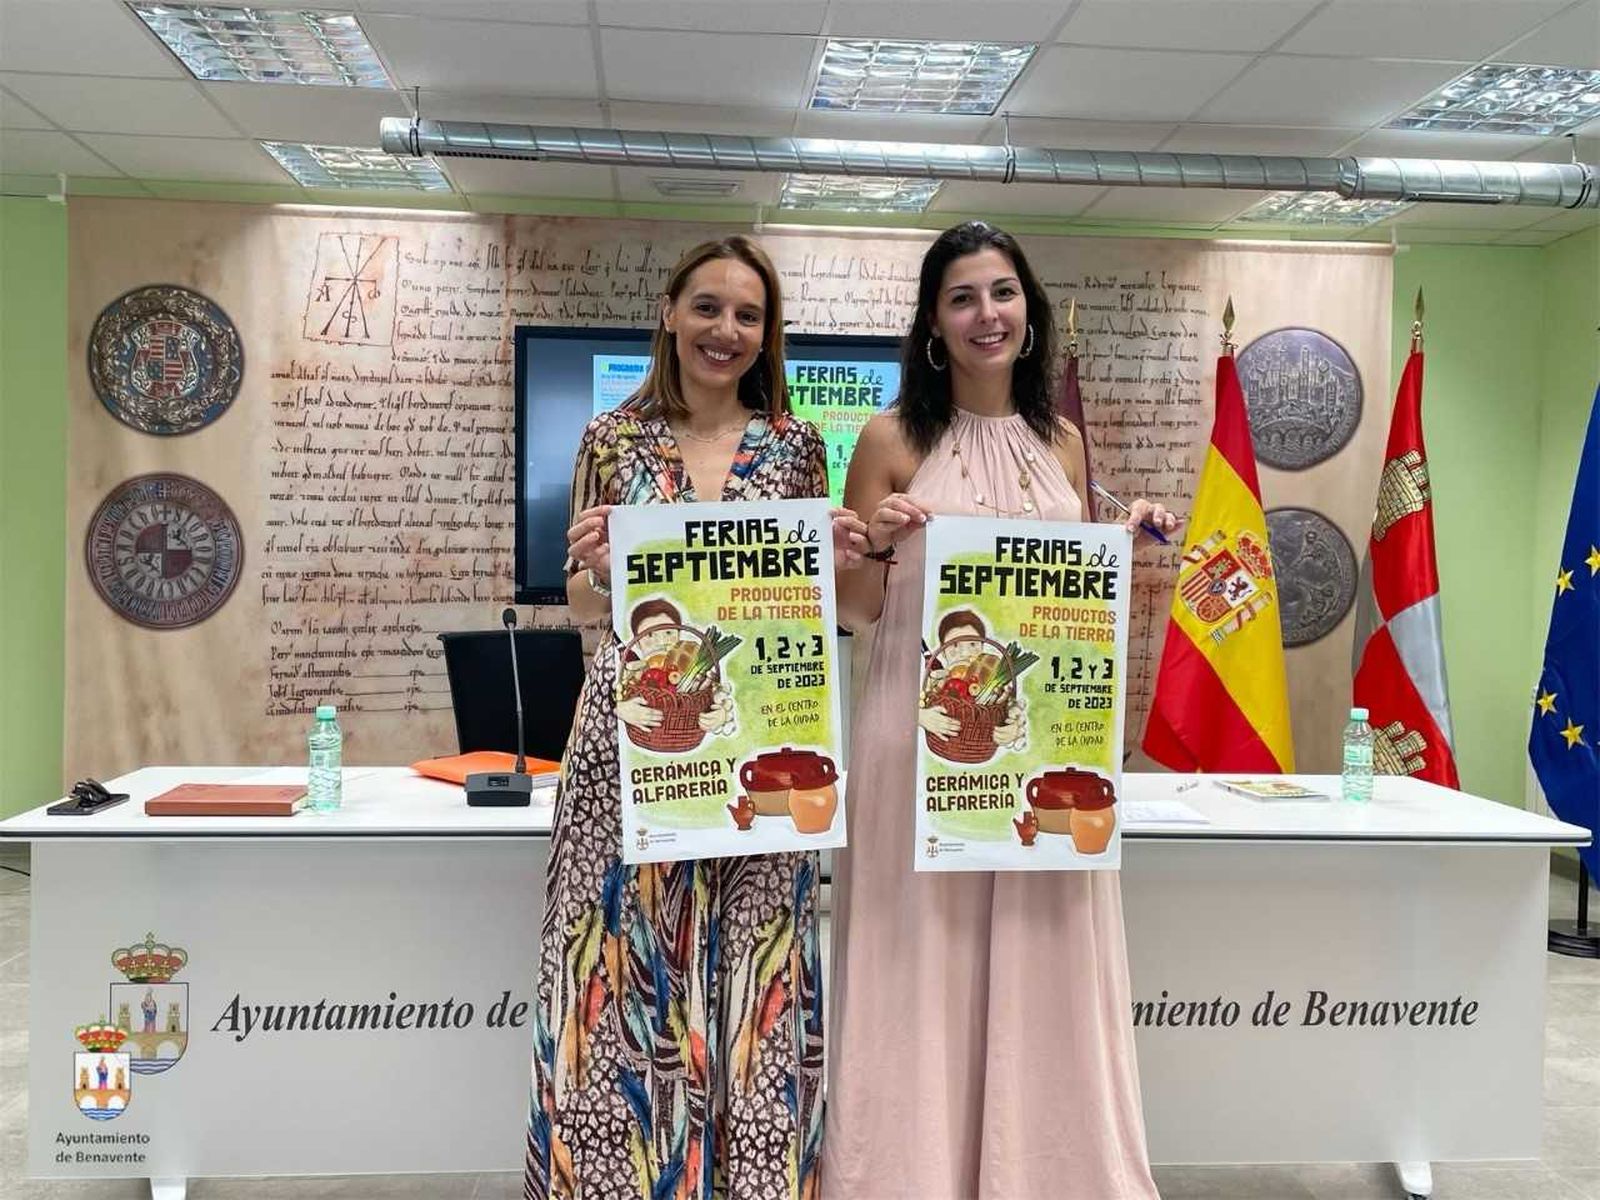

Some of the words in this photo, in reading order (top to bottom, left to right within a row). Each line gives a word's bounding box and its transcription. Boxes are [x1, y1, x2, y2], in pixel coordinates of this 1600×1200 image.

[796, 366, 857, 384] FERIAS
[860, 368, 884, 386] de
[788, 385, 883, 406] TIEMBRE
[823, 411, 871, 422] PRODUCT
[685, 518, 780, 548] FERIAS
[784, 520, 821, 544] de
[995, 536, 1082, 566] FERIAS
[1085, 543, 1120, 568] de
[627, 546, 820, 585] SEPTIEMBRE
[939, 564, 1118, 600] SEPTIEMBRE
[730, 586, 822, 602] PRODUCTOS
[718, 606, 736, 621] DE
[743, 606, 762, 620] LA
[769, 604, 822, 620] TIERRA
[1033, 605, 1117, 625] PRODUCTOS
[1019, 623, 1037, 638] DE
[1042, 624, 1061, 640] LA
[1066, 625, 1115, 642] TIERRA
[755, 637, 772, 662] 1,
[777, 636, 791, 659] 2
[811, 635, 824, 656] 3
[751, 664, 763, 674] DE
[767, 661, 824, 674] SEPTIEMBRE
[1051, 656, 1065, 682] 1,
[1071, 657, 1082, 679] 2
[1102, 657, 1113, 679] 3
[777, 678, 791, 689] DE
[795, 674, 825, 688] 2023
[1045, 683, 1057, 693] DE
[1060, 683, 1113, 694] SEPTIEMBRE
[761, 704, 773, 715] EN
[776, 703, 786, 713] EL
[788, 699, 819, 712] CENTRO
[1068, 698, 1081, 709] DE
[1084, 696, 1112, 709] 2023
[768, 717, 779, 727] DE
[781, 715, 792, 726] LA
[631, 759, 721, 785] CERÁMICA
[727, 758, 737, 773] Y
[926, 771, 1010, 792] CERÁMICA
[1015, 773, 1025, 788] Y
[632, 778, 728, 804] ALFARERÍA
[926, 790, 1015, 812] ALFARERÍA
[210, 991, 474, 1042] Ayuntamiento
[485, 991, 529, 1029] de
[1131, 990, 1240, 1027] miento
[1252, 990, 1291, 1027] de
[1300, 990, 1480, 1027] Benavente
